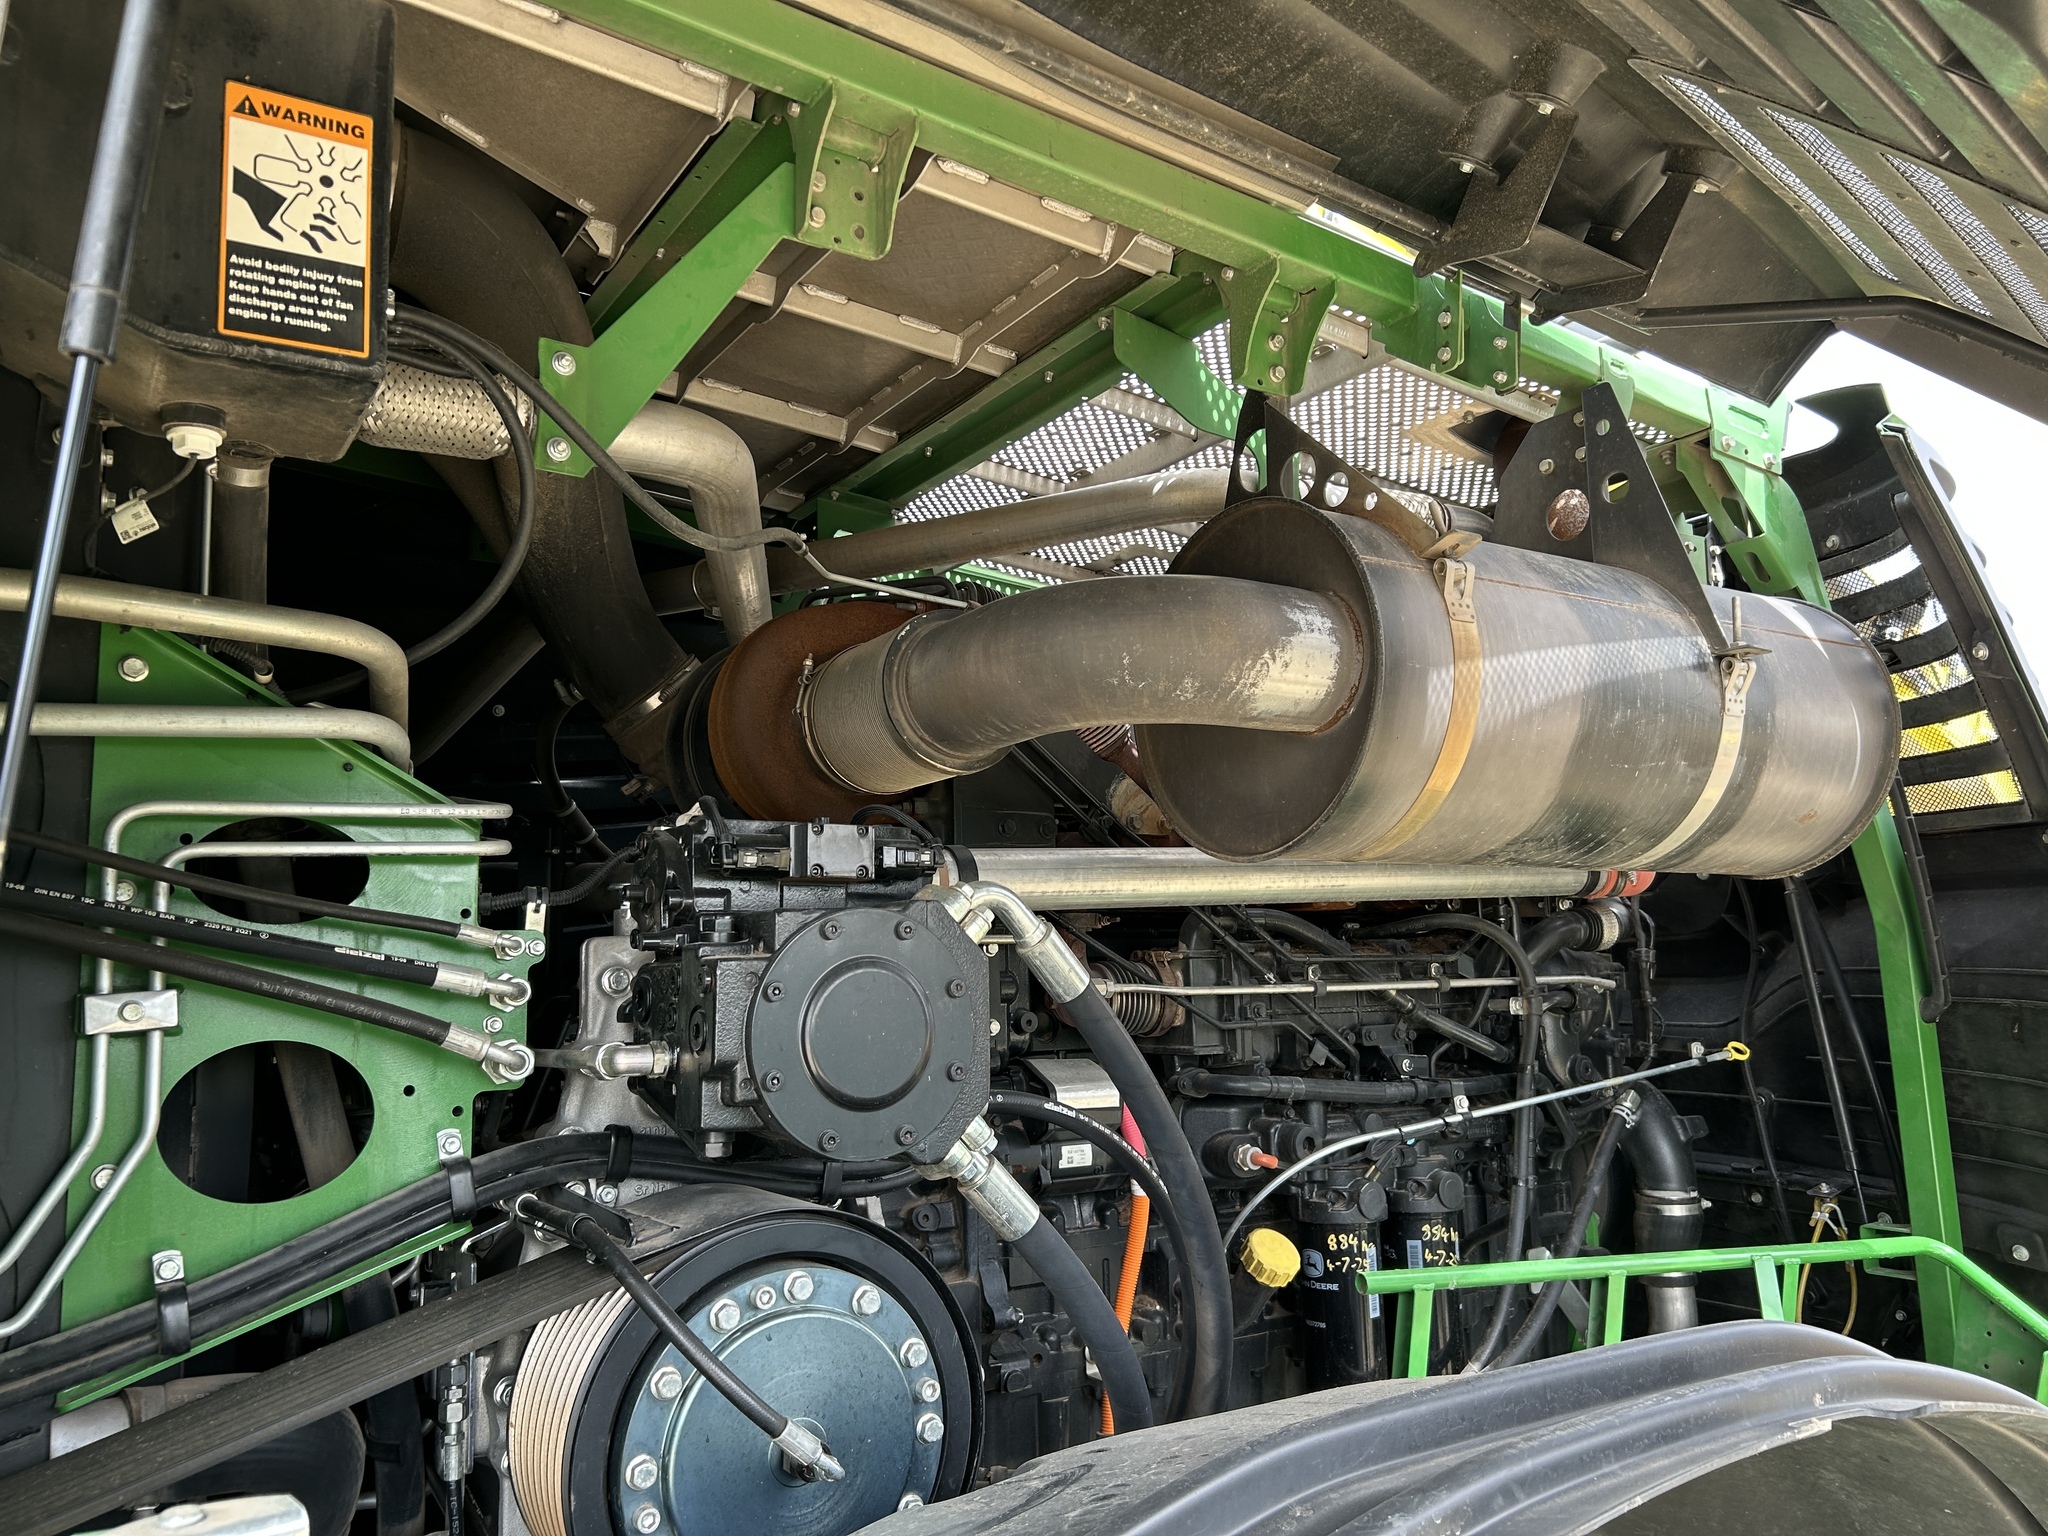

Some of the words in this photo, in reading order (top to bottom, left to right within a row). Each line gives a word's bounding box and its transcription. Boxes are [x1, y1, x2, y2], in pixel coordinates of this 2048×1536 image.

[261, 101, 365, 139] WARNING
[229, 254, 263, 268] Avoid
[264, 260, 300, 276] bodily
[302, 268, 335, 283] injury
[336, 275, 363, 288] from
[229, 268, 276, 285] rotating
[278, 277, 317, 292] engine
[319, 284, 341, 296] fan.
[228, 293, 286, 311] discharge
[288, 304, 315, 316] area
[316, 309, 347, 322] when
[229, 280, 260, 293] Keep
[262, 286, 298, 300] hands
[299, 294, 319, 305] out
[321, 298, 334, 307] of
[335, 299, 354, 311] fan
[228, 306, 268, 320] engine
[270, 313, 282, 323] is
[284, 316, 332, 332] running.
[34, 887, 48, 896] DIN
[49, 890, 60, 898] EN
[103, 901, 116, 909] DN
[117, 903, 126, 911] 12
[130, 906, 143, 915] WP
[159, 912, 176, 921] BAR
[221, 924, 233, 933] PSI
[253, 980, 281, 994] ITALY
[283, 988, 295, 997] IN
[298, 991, 320, 1003] MADE
[1327, 1233, 1359, 1254] 884
[1422, 1224, 1449, 1243] 884
[1310, 1280, 1340, 1291] DEERE
